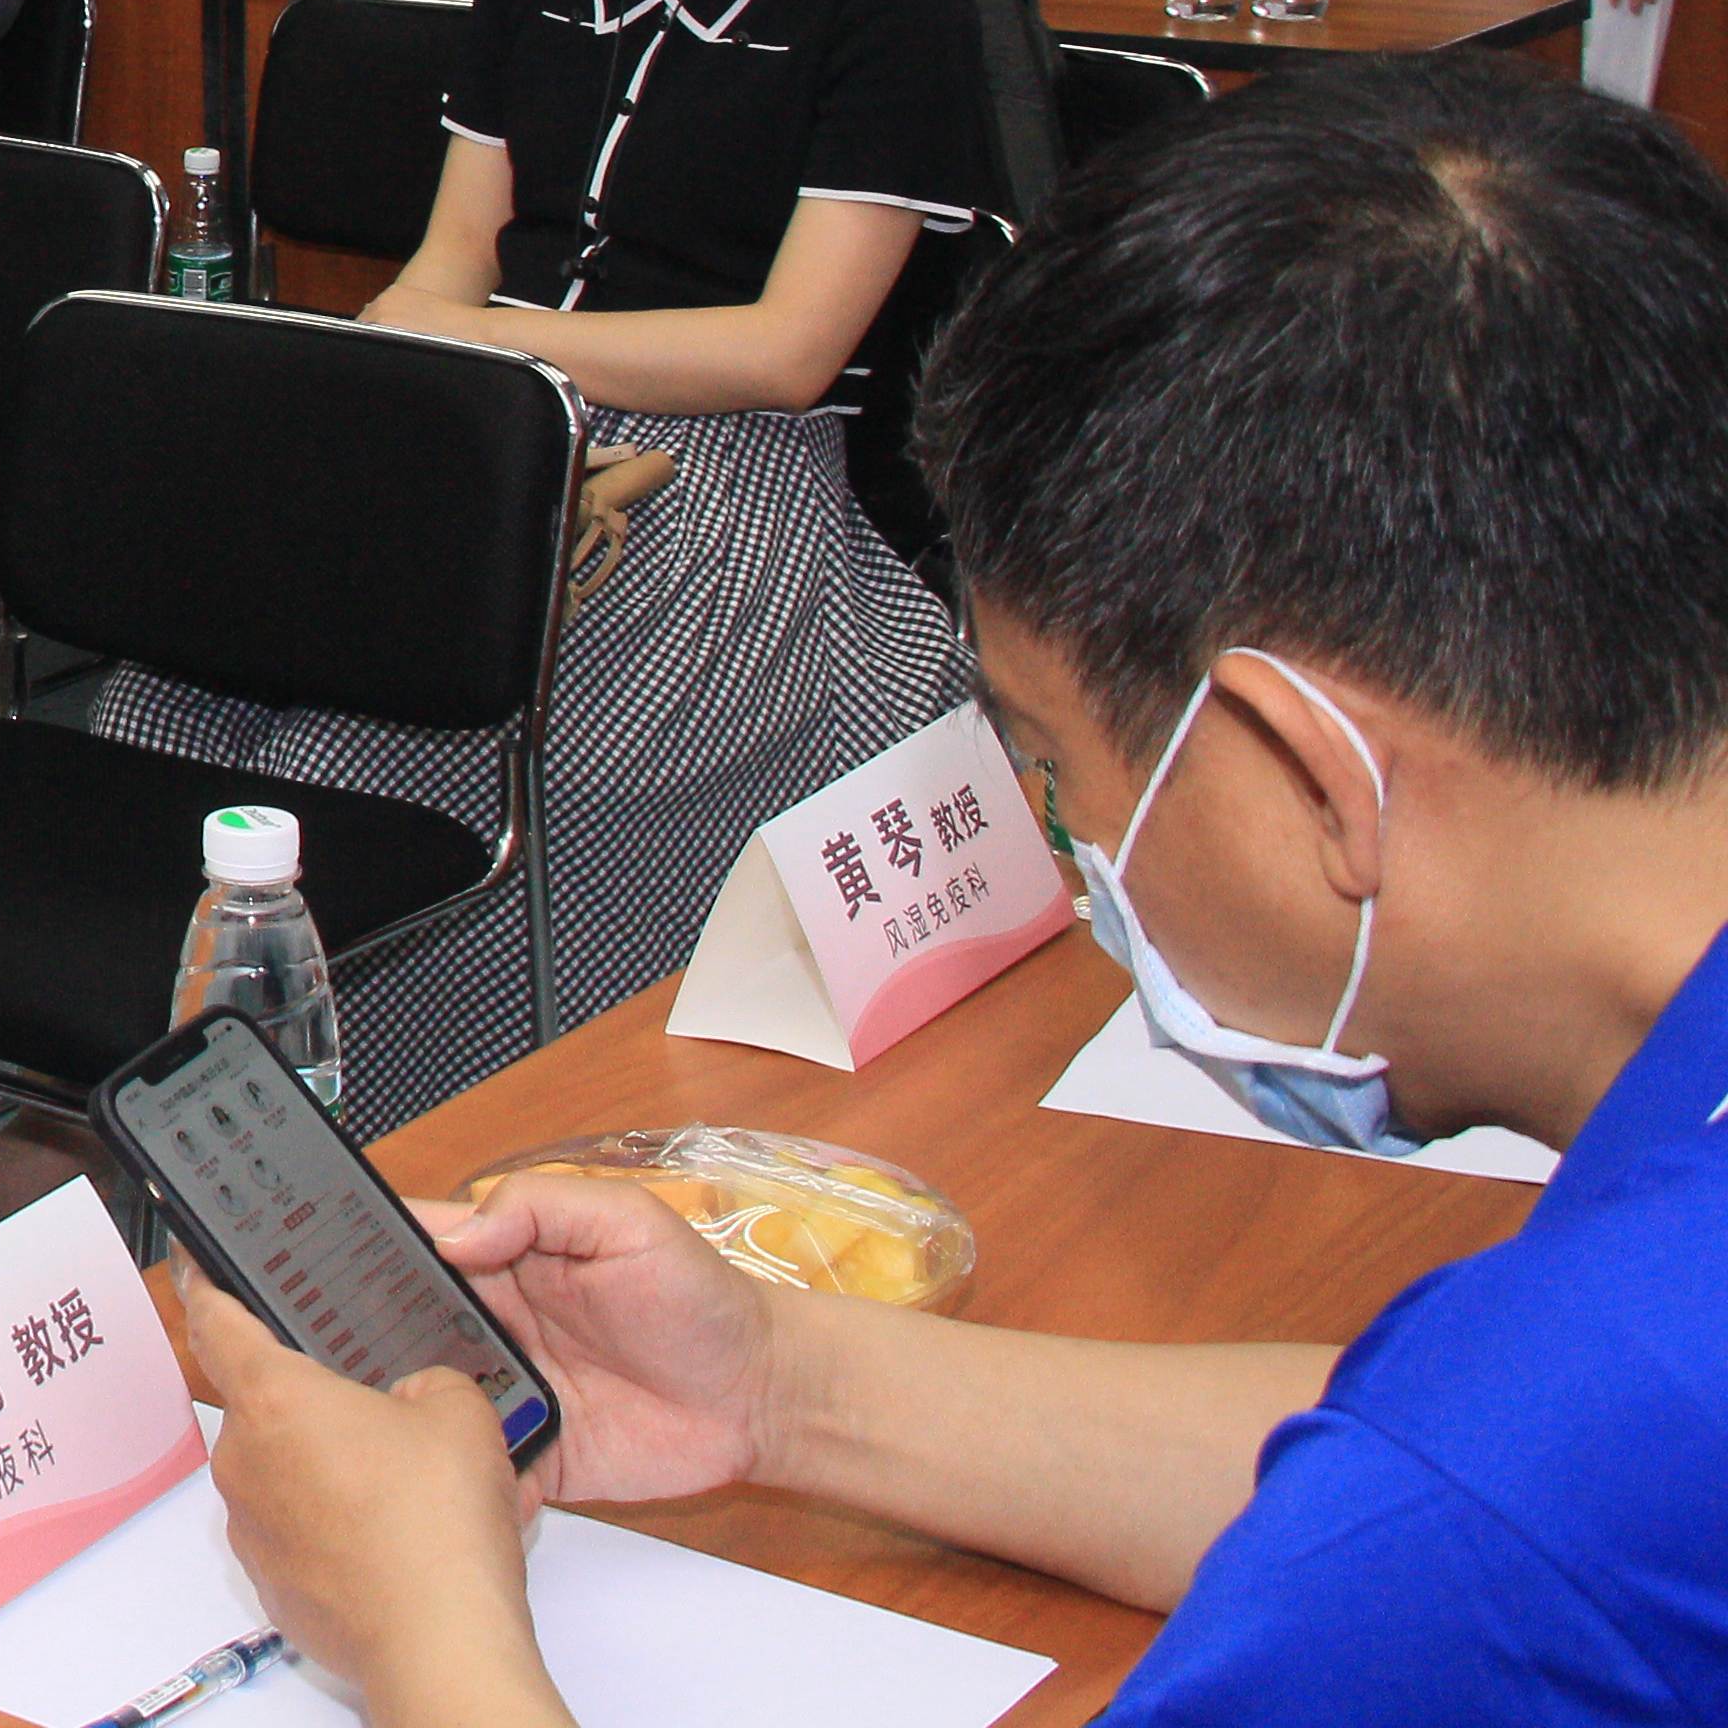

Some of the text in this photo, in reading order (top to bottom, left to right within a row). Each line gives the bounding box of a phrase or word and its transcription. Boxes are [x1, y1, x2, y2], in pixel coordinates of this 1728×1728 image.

[929, 784, 991, 854] 教授
[883, 862, 992, 959] 风湿免疫科
[12, 1287, 104, 1386] 教授
